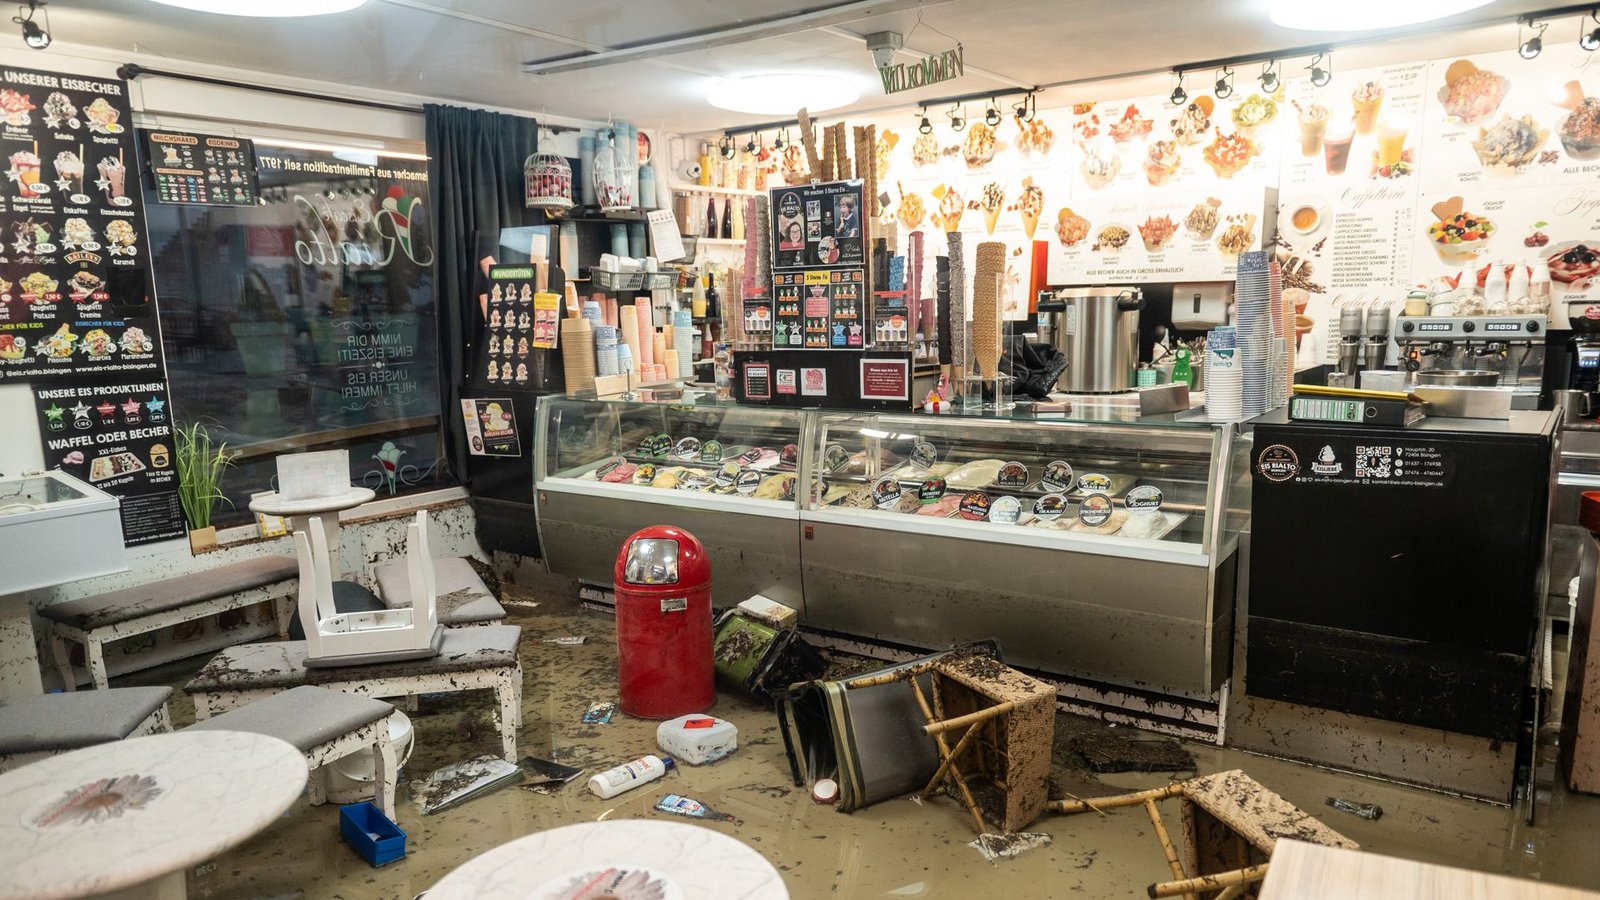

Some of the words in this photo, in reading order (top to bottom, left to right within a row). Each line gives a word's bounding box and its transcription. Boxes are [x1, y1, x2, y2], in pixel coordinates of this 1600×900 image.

[880, 46, 963, 94] WILLKOMMEN
[4, 71, 59, 88] UNSERER
[62, 78, 122, 96] EISBECHER
[93, 136, 118, 144] Spaghetti
[154, 134, 196, 144] MILCHSHAKES
[14, 204, 28, 212] Engel
[494, 270, 531, 278] WUNDERTÜTEN
[30, 304, 57, 312] Spaghetti
[6, 368, 72, 377] @eis.rialto.bisingen
[76, 363, 157, 373] www.eis-rialto-bisingen.de
[39, 388, 76, 399] UNSERE
[78, 386, 92, 396] EIS
[94, 383, 164, 395] PRODUKTLINIEN
[48, 435, 94, 450] WAFFEL
[97, 431, 126, 444] ODER
[131, 426, 170, 438] BECHER
[99, 446, 127, 456] XXL-Eisbox
[119, 476, 134, 485] Kugeln
[879, 492, 900, 503] NUTELLA
